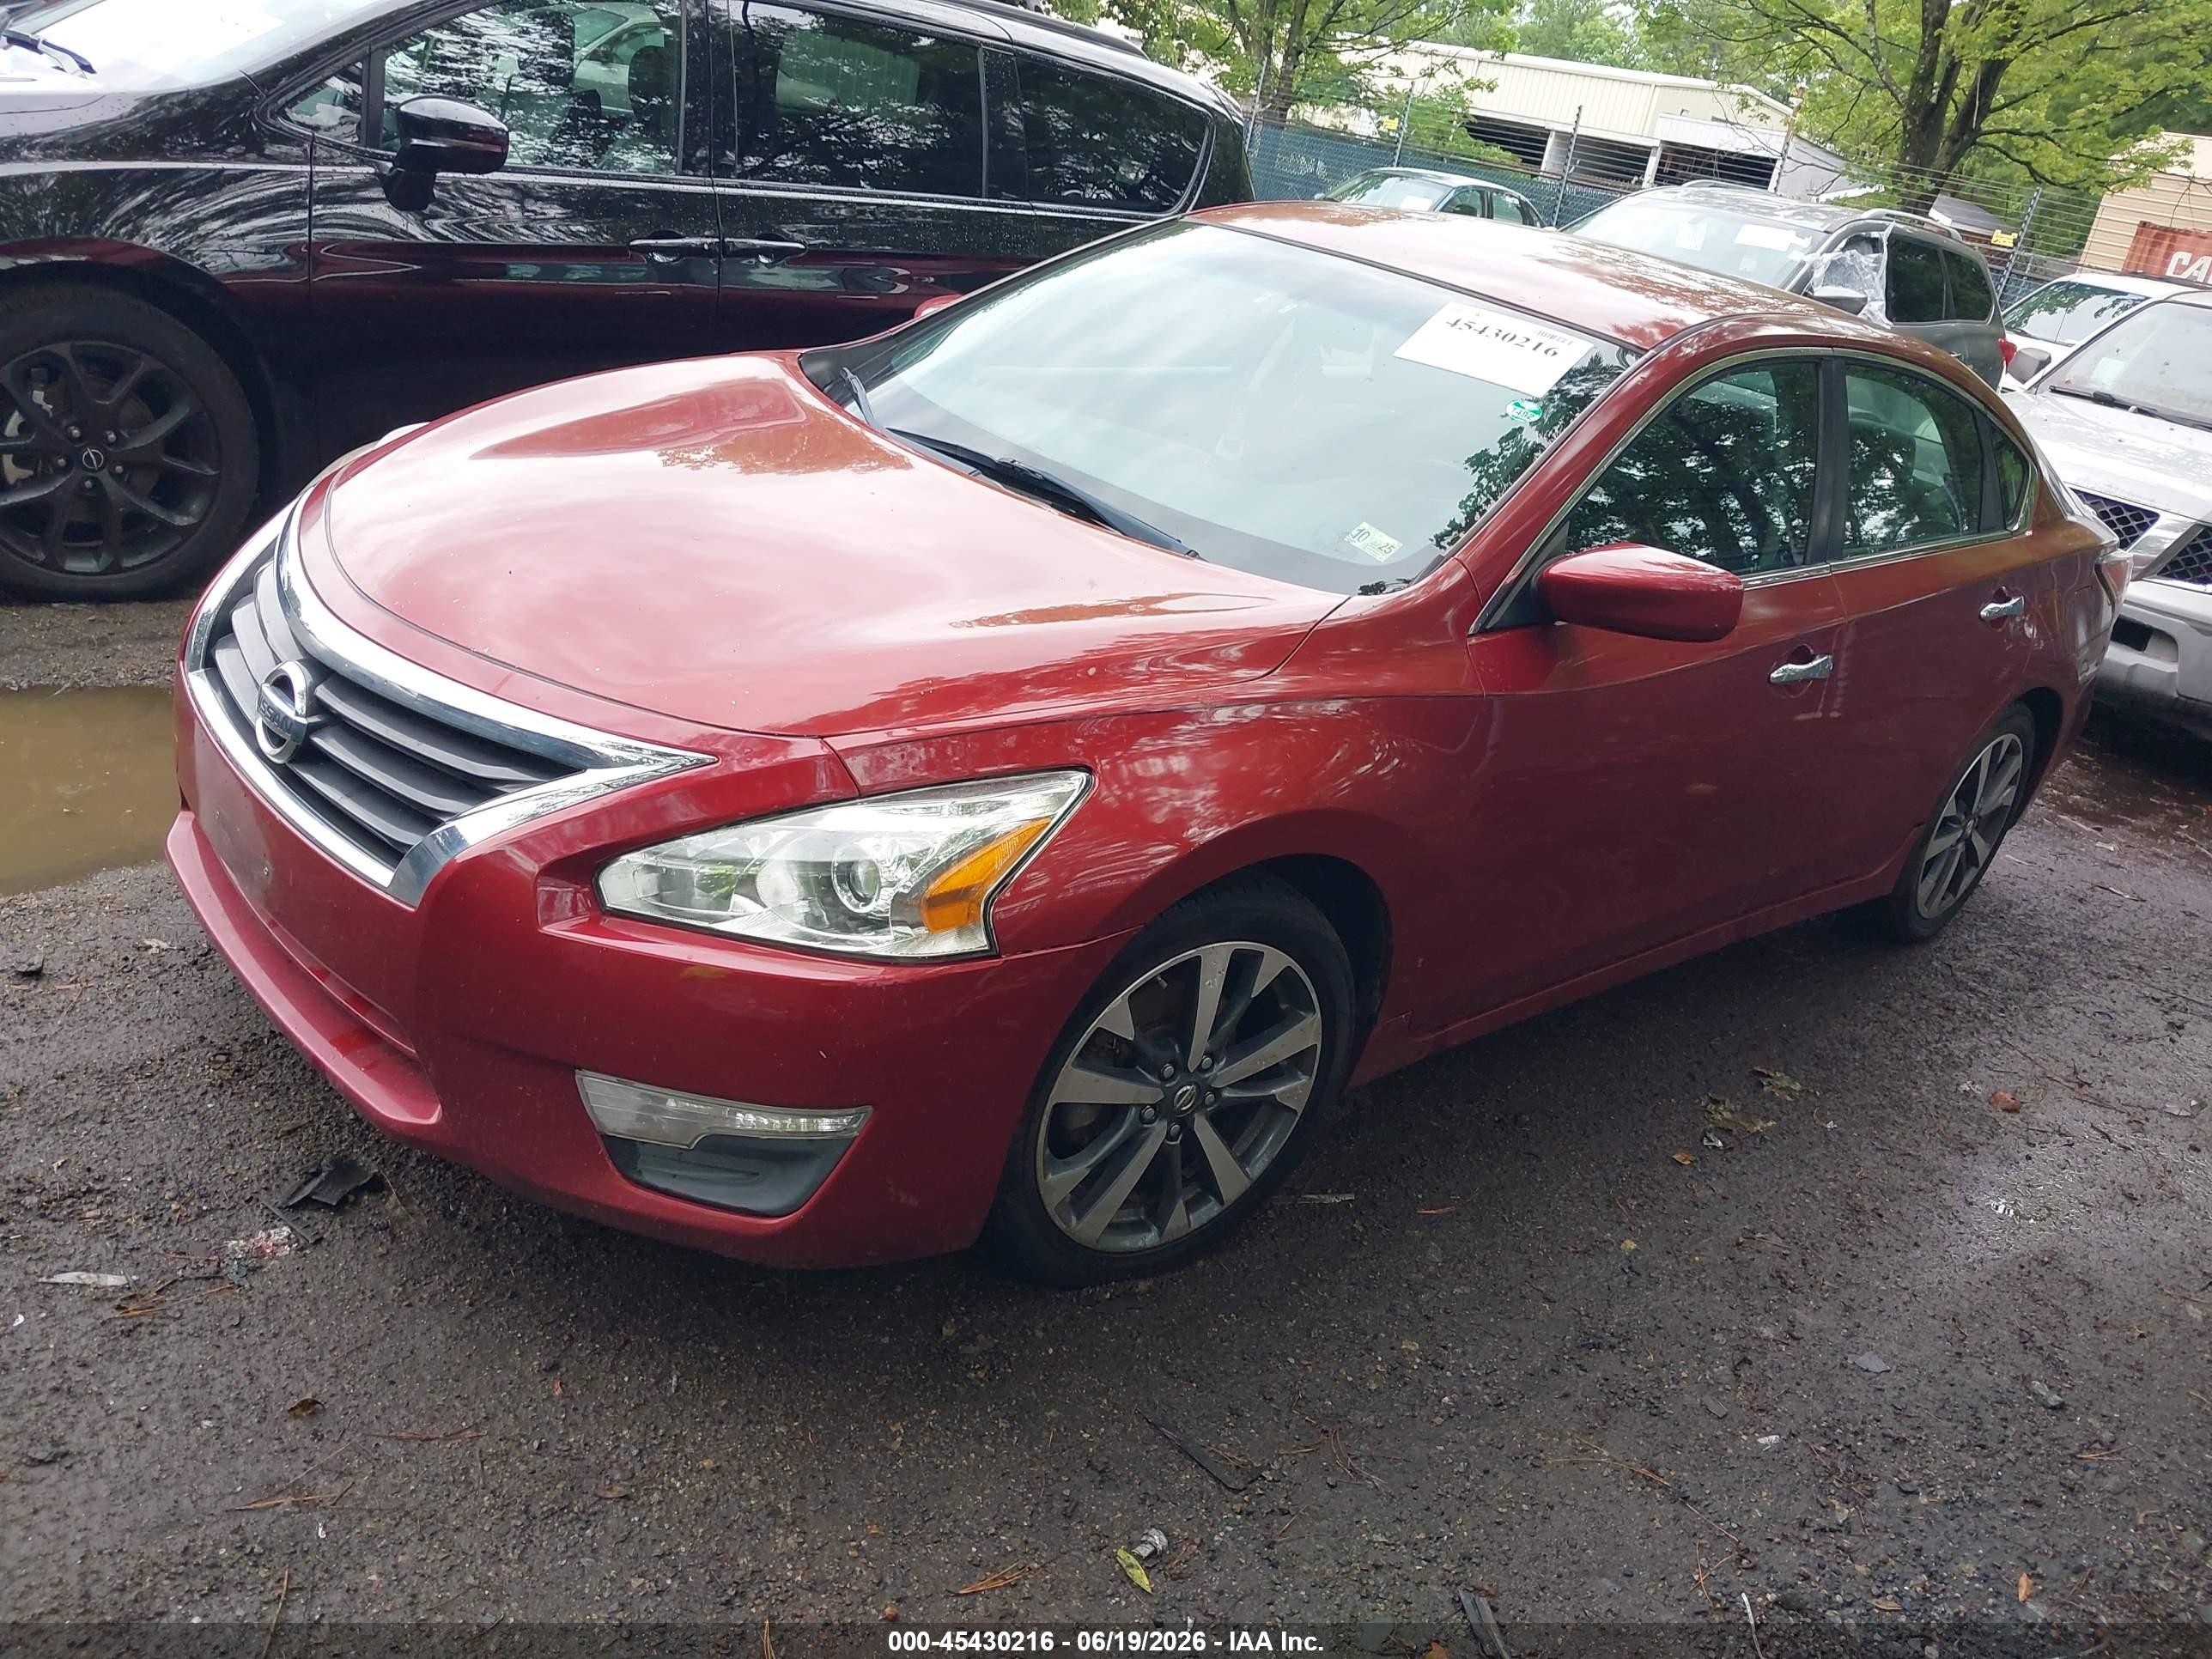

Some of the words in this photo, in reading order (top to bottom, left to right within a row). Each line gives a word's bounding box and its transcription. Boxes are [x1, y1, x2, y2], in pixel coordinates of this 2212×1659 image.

[2166, 251, 2212, 283] CA
[1445, 318, 1559, 357] 45430216
[1377, 542, 1395, 555] 25
